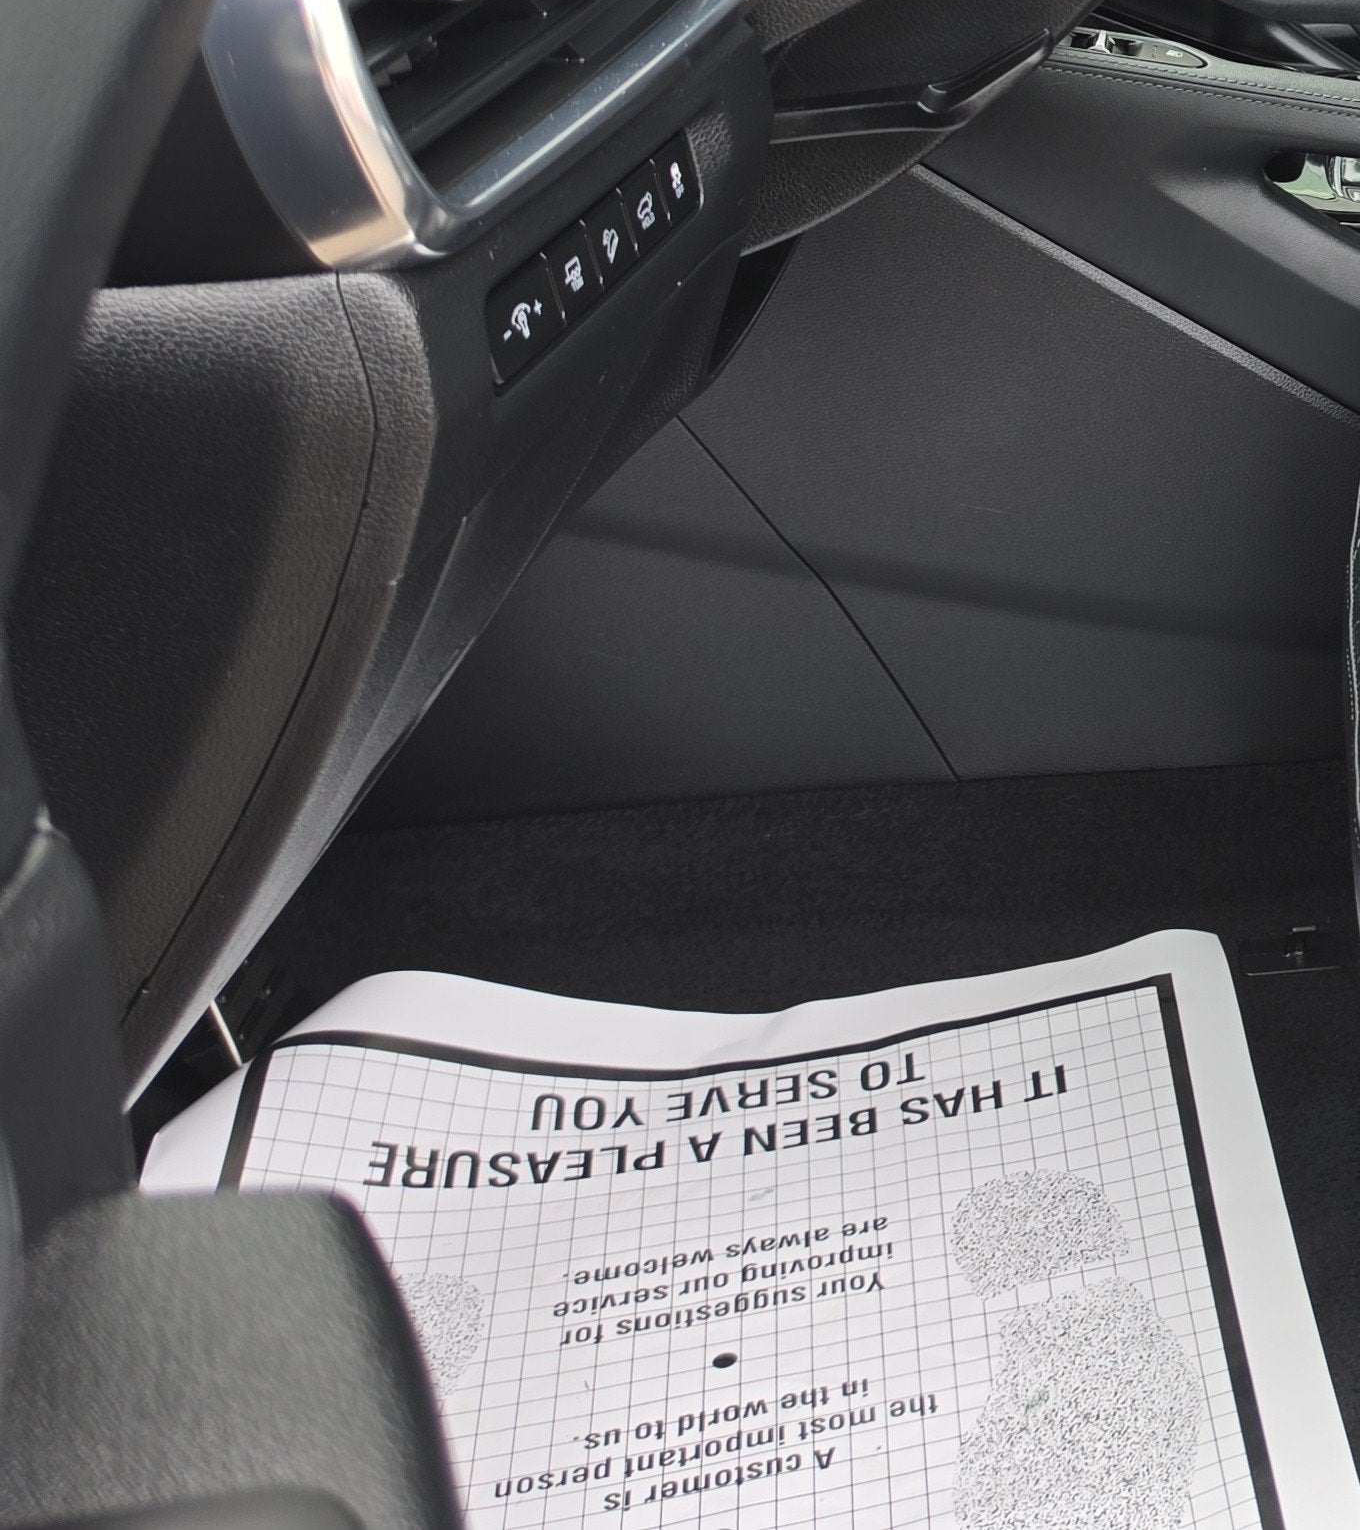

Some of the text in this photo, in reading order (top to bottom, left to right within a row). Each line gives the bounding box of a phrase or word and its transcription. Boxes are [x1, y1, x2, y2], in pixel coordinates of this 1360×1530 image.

[361, 1064, 1068, 1189] IT HAS BEEN A PLEASURE
[530, 1051, 927, 1132] TO SERVE YOU
[552, 1240, 894, 1320] improving our service
[562, 1215, 889, 1286] are always welcome.
[559, 1270, 886, 1349] Your suggestions for
[494, 1393, 938, 1500] the most important person
[574, 1377, 869, 1451] in the world to us.
[603, 1445, 835, 1512] A customer is
